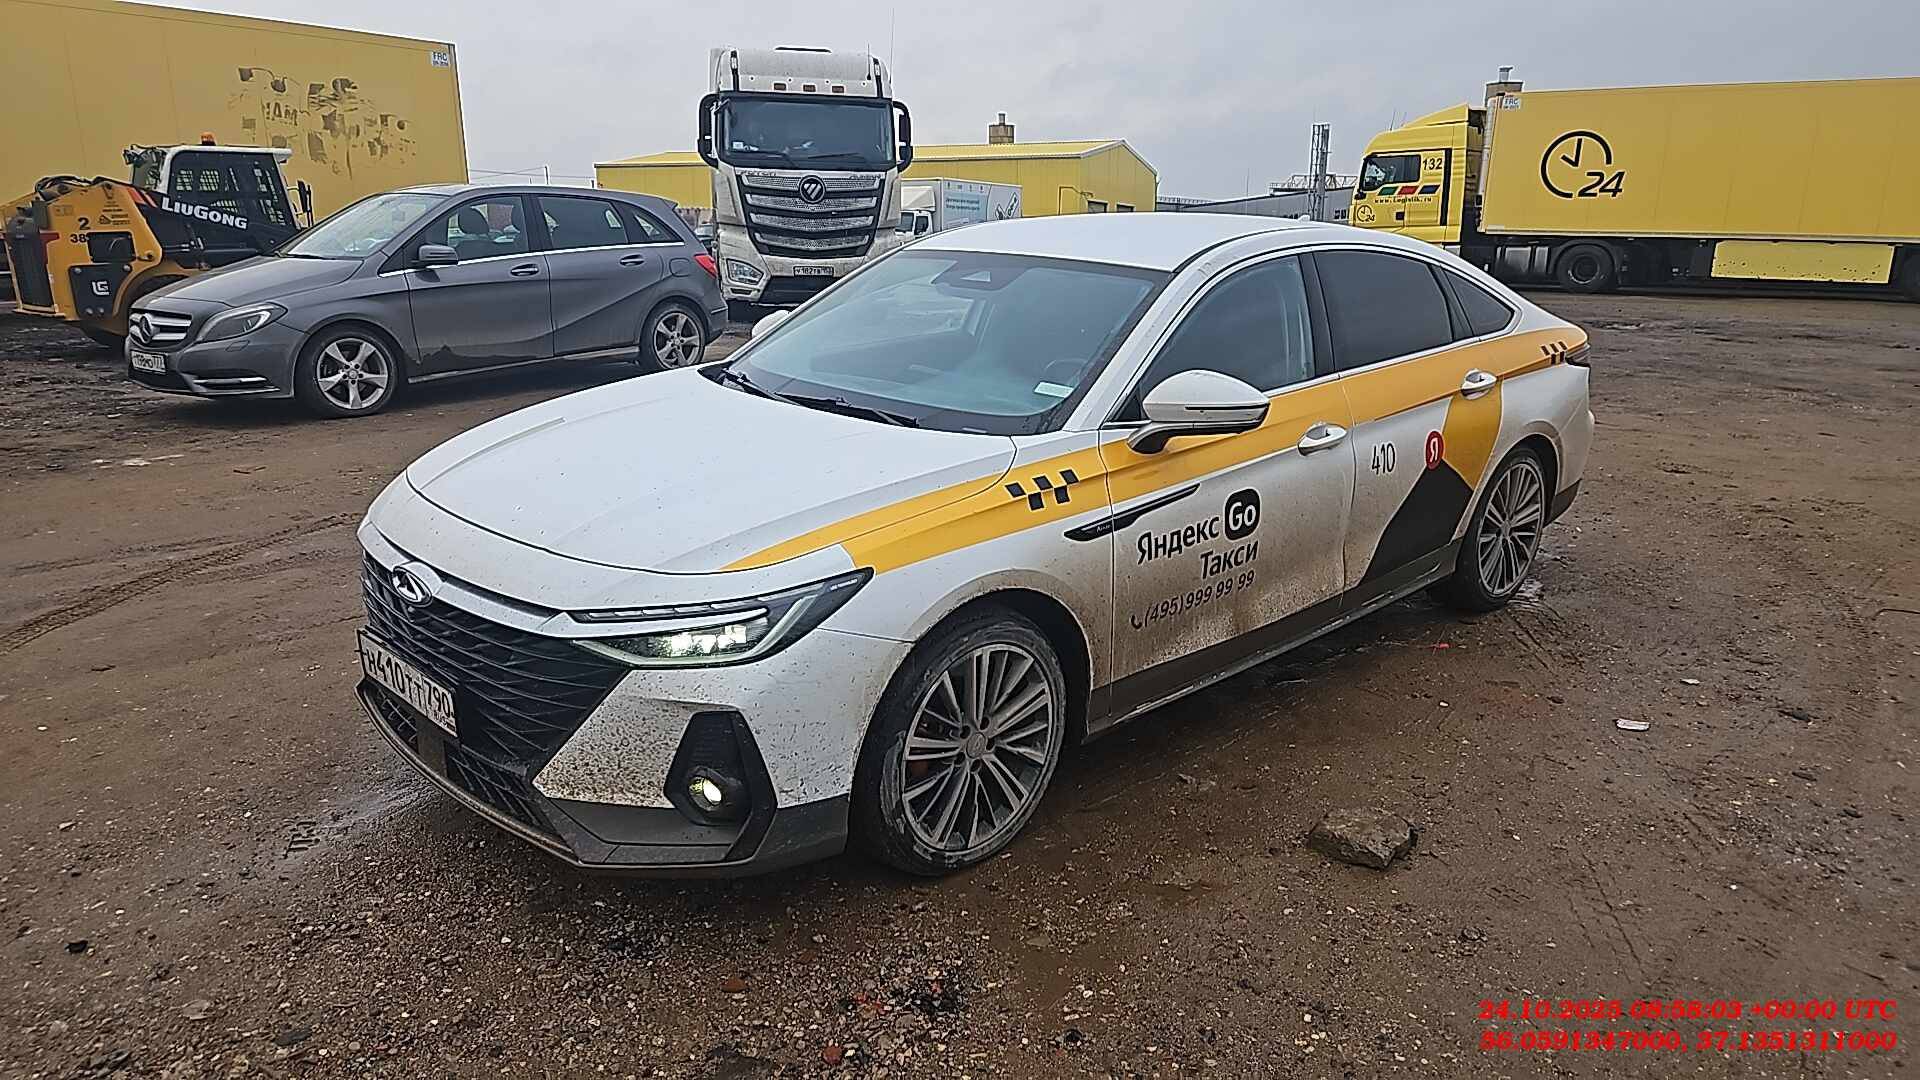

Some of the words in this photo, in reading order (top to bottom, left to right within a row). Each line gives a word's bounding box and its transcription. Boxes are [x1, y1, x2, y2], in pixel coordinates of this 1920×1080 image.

[1422, 157, 1443, 171] 132
[1577, 171, 1626, 198] 24
[77, 217, 91, 231] 2
[161, 196, 248, 230] LIUGONG
[1371, 442, 1396, 476] 410
[1137, 516, 1220, 565] Яндекс
[1228, 501, 1257, 530] Go
[1200, 540, 1259, 580] Такси
[1215, 578, 1233, 600] 99
[1237, 569, 1255, 591] 99
